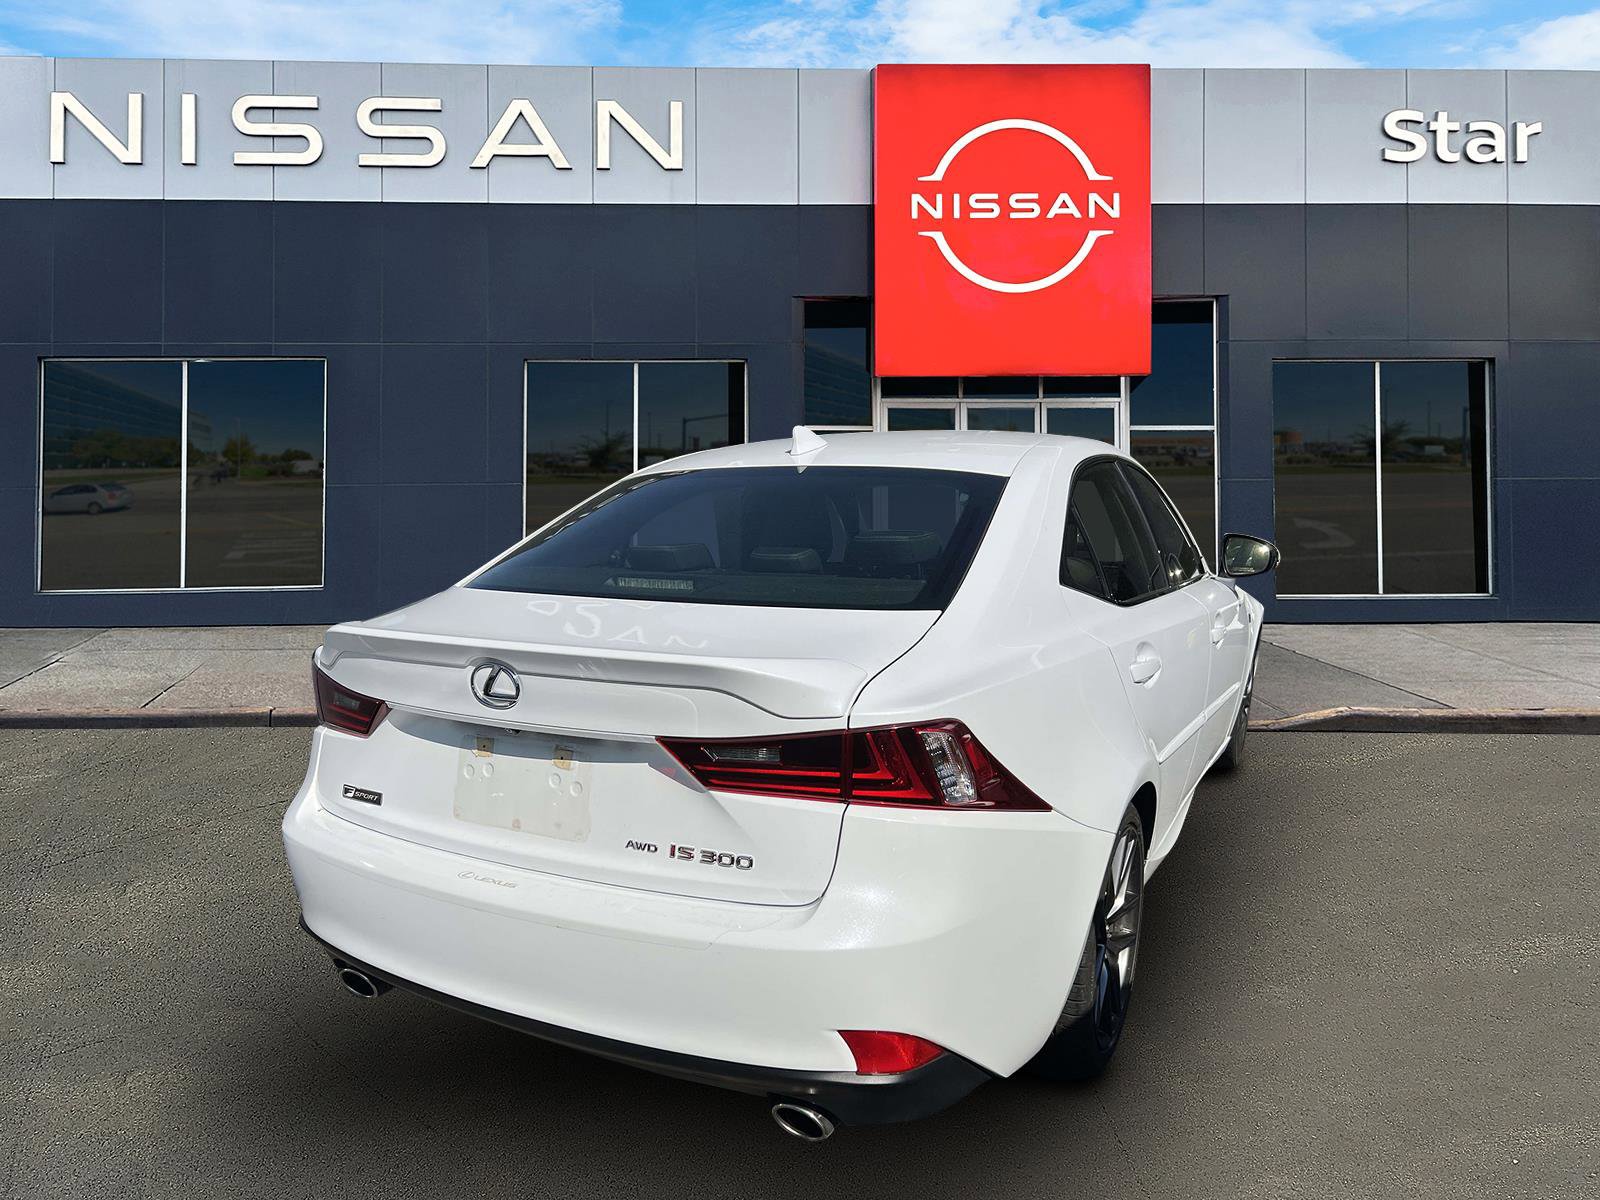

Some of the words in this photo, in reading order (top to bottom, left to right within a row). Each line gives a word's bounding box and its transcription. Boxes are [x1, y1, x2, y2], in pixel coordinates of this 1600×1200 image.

[49, 92, 684, 171] NISSAN
[1382, 109, 1543, 164] Star
[911, 191, 1121, 220] NISSAN
[354, 791, 379, 801] SPORT
[624, 839, 659, 854] AWD
[669, 843, 695, 861] IS
[699, 848, 754, 871] 300
[474, 875, 517, 889] LEXUS
